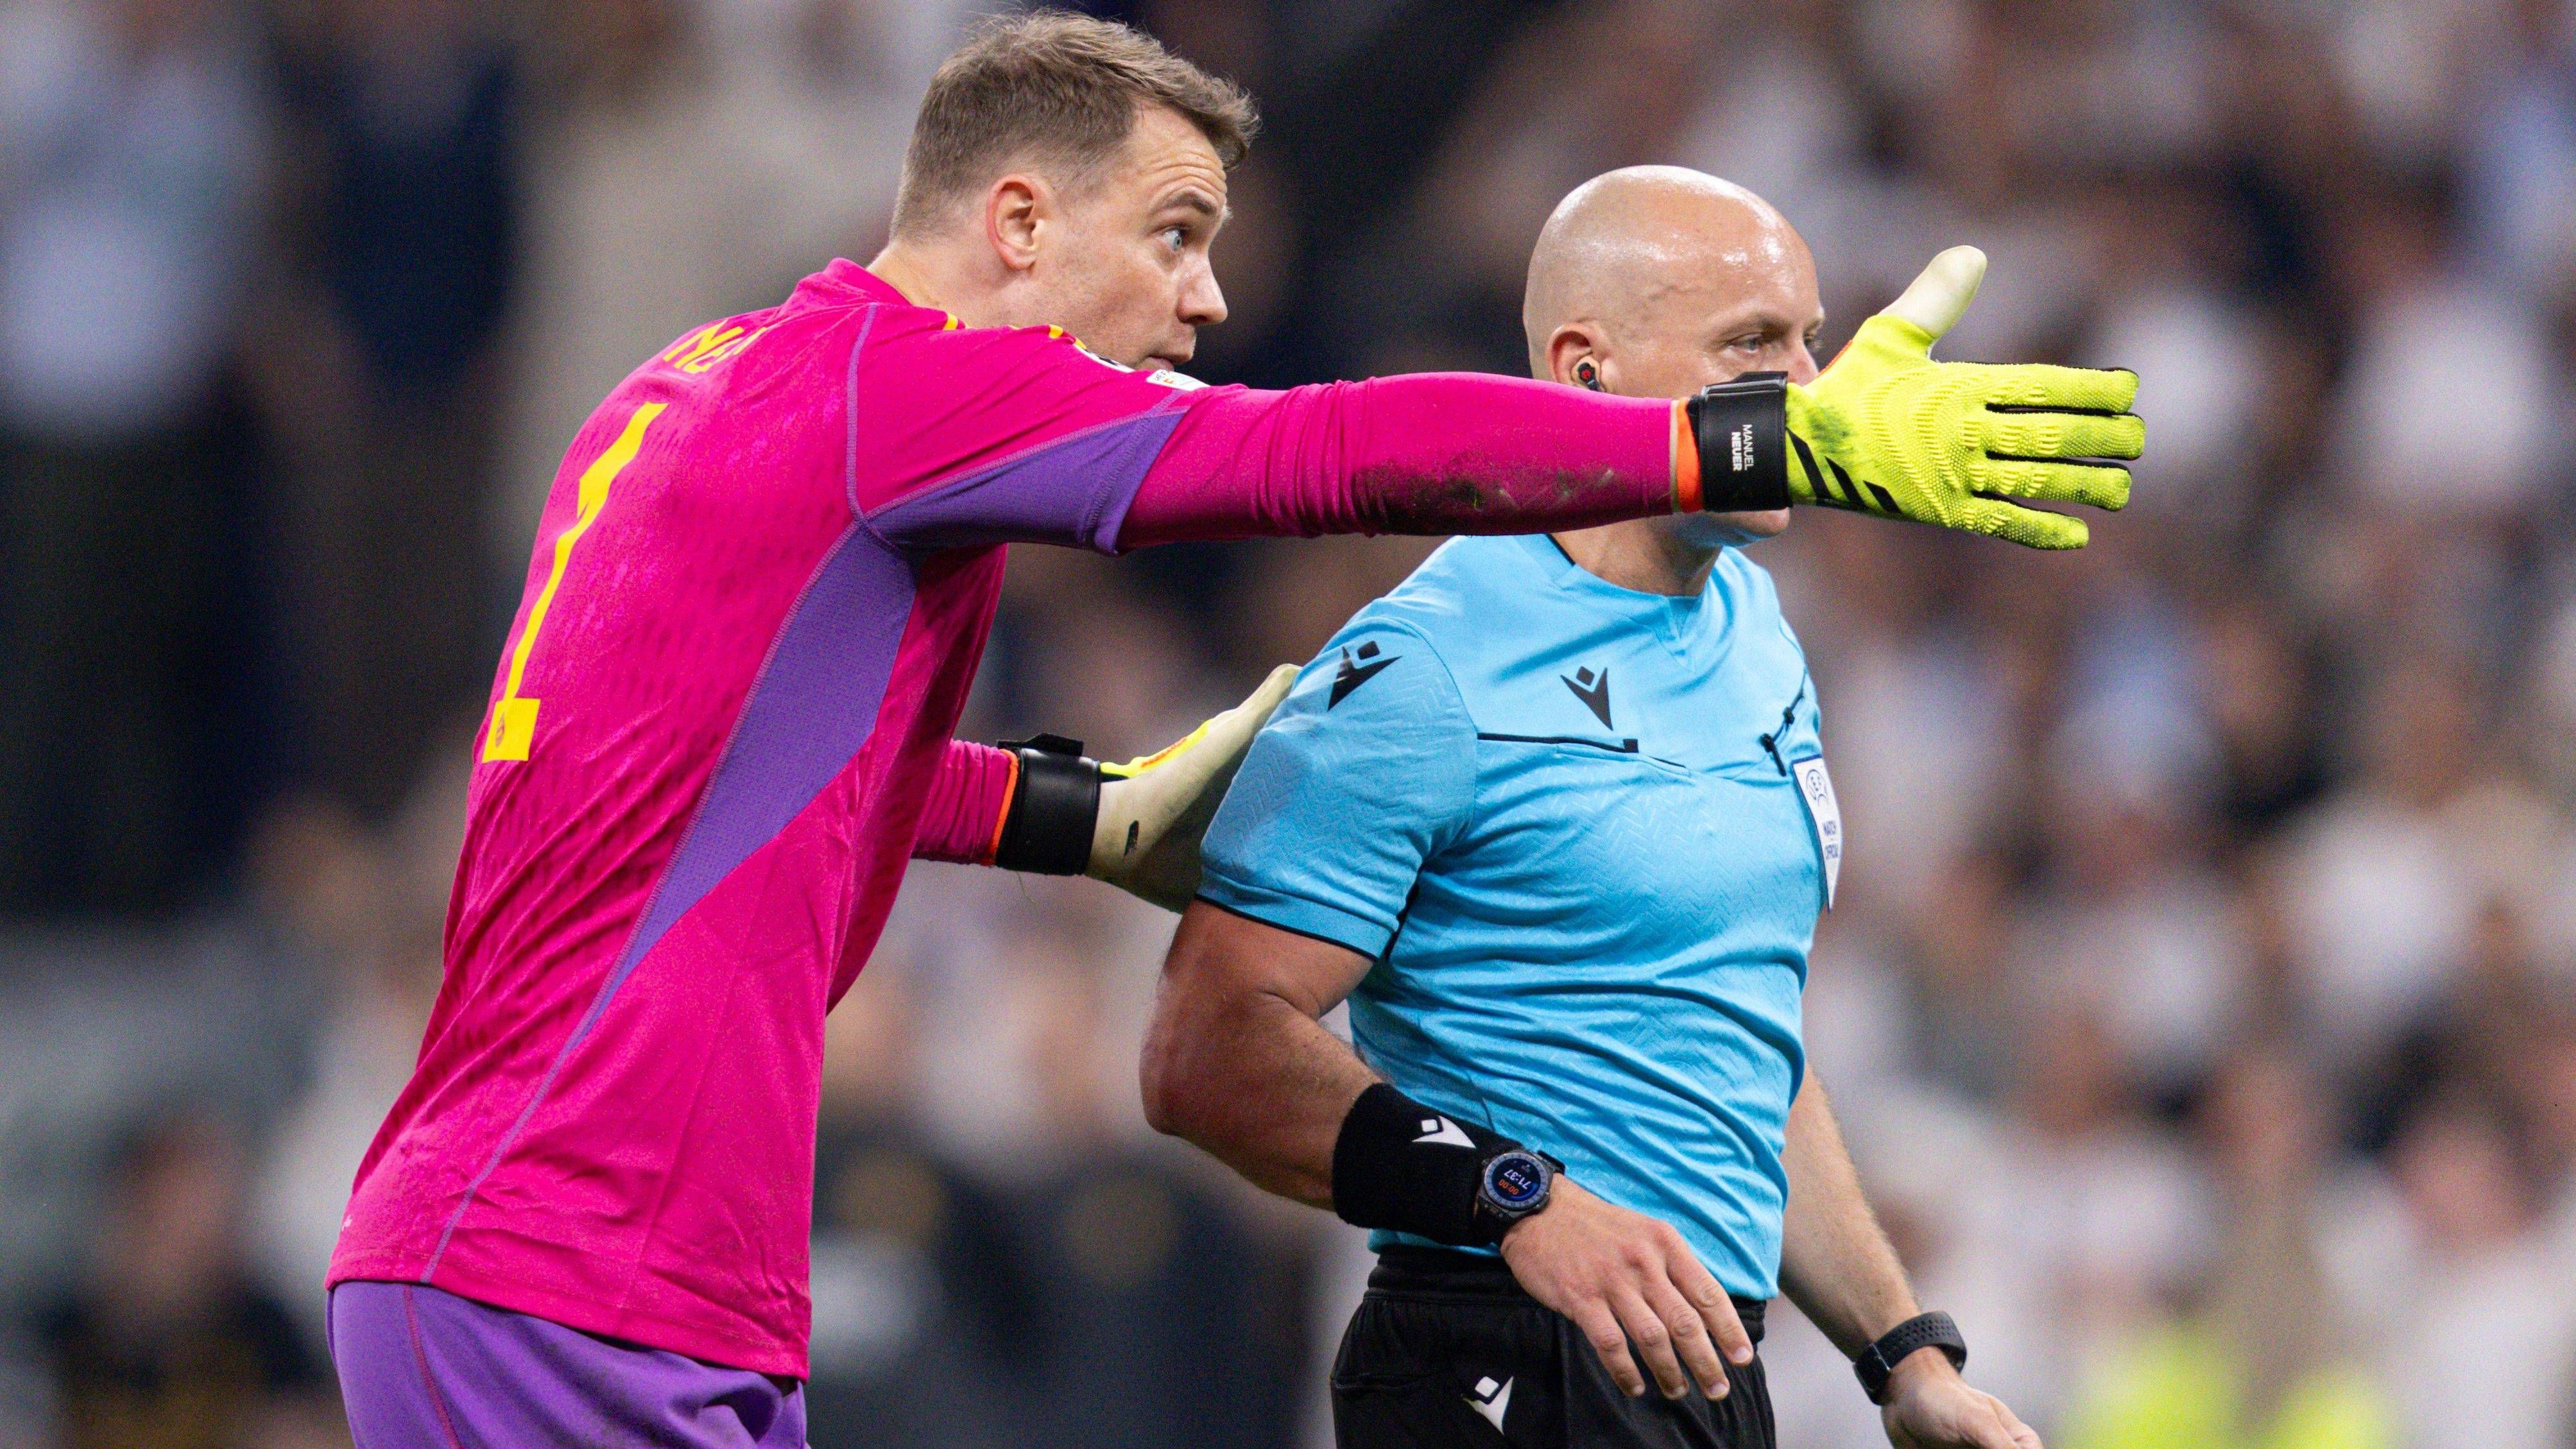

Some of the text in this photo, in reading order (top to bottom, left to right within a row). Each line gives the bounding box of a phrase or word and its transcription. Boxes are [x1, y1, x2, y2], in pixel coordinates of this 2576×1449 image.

[1732, 432, 1742, 471] NEUER
[1743, 424, 1754, 470] MANUEL
[482, 401, 669, 763] 1
[1504, 1169, 1531, 1189] 71:37
